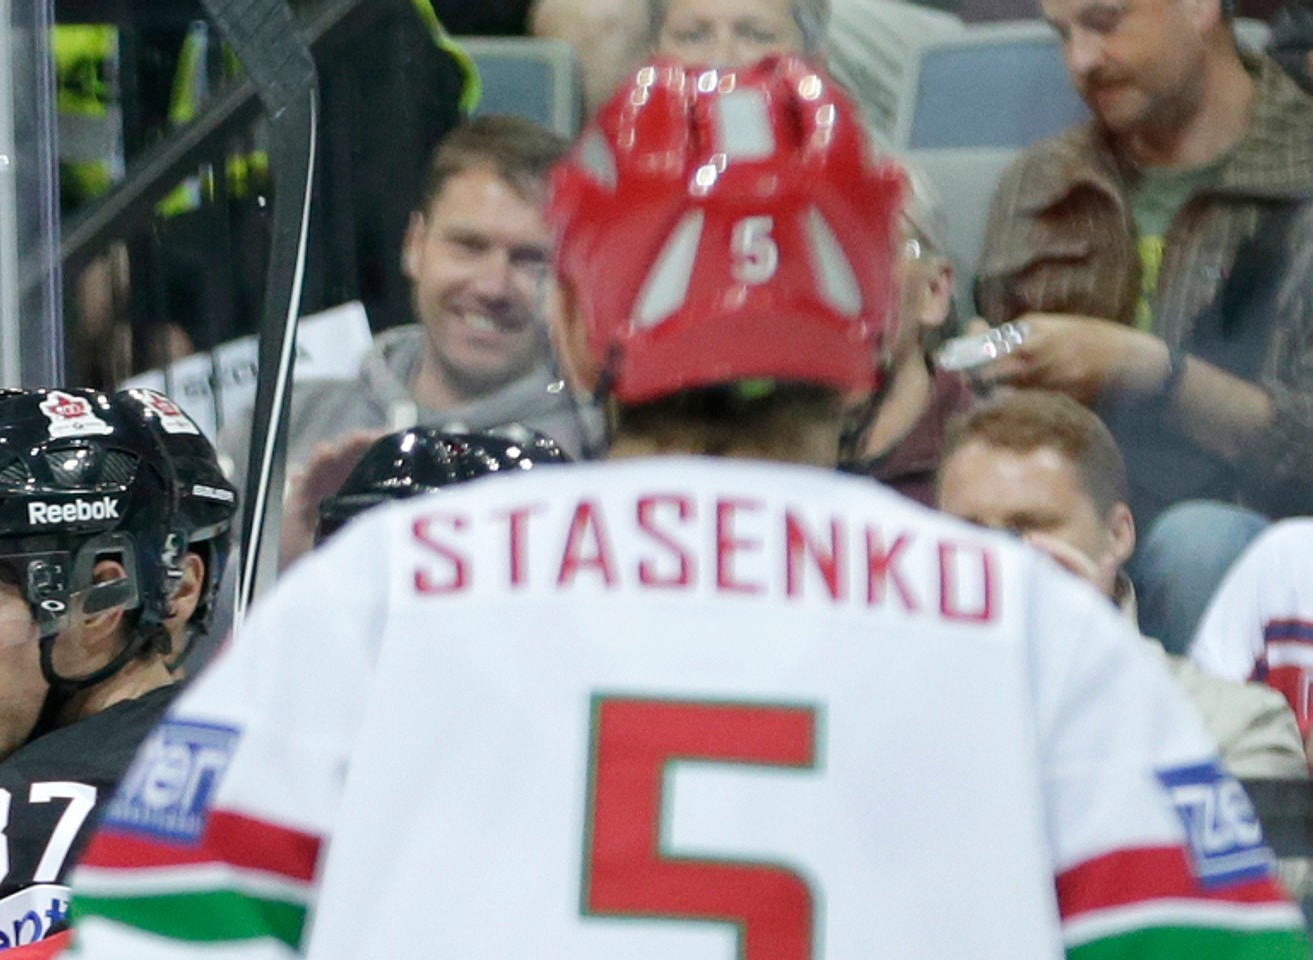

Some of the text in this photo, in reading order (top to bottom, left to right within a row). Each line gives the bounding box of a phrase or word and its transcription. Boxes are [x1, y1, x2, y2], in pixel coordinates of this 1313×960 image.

[730, 216, 779, 284] 5
[28, 496, 120, 526] Reebok
[409, 492, 1005, 625] STASENKO
